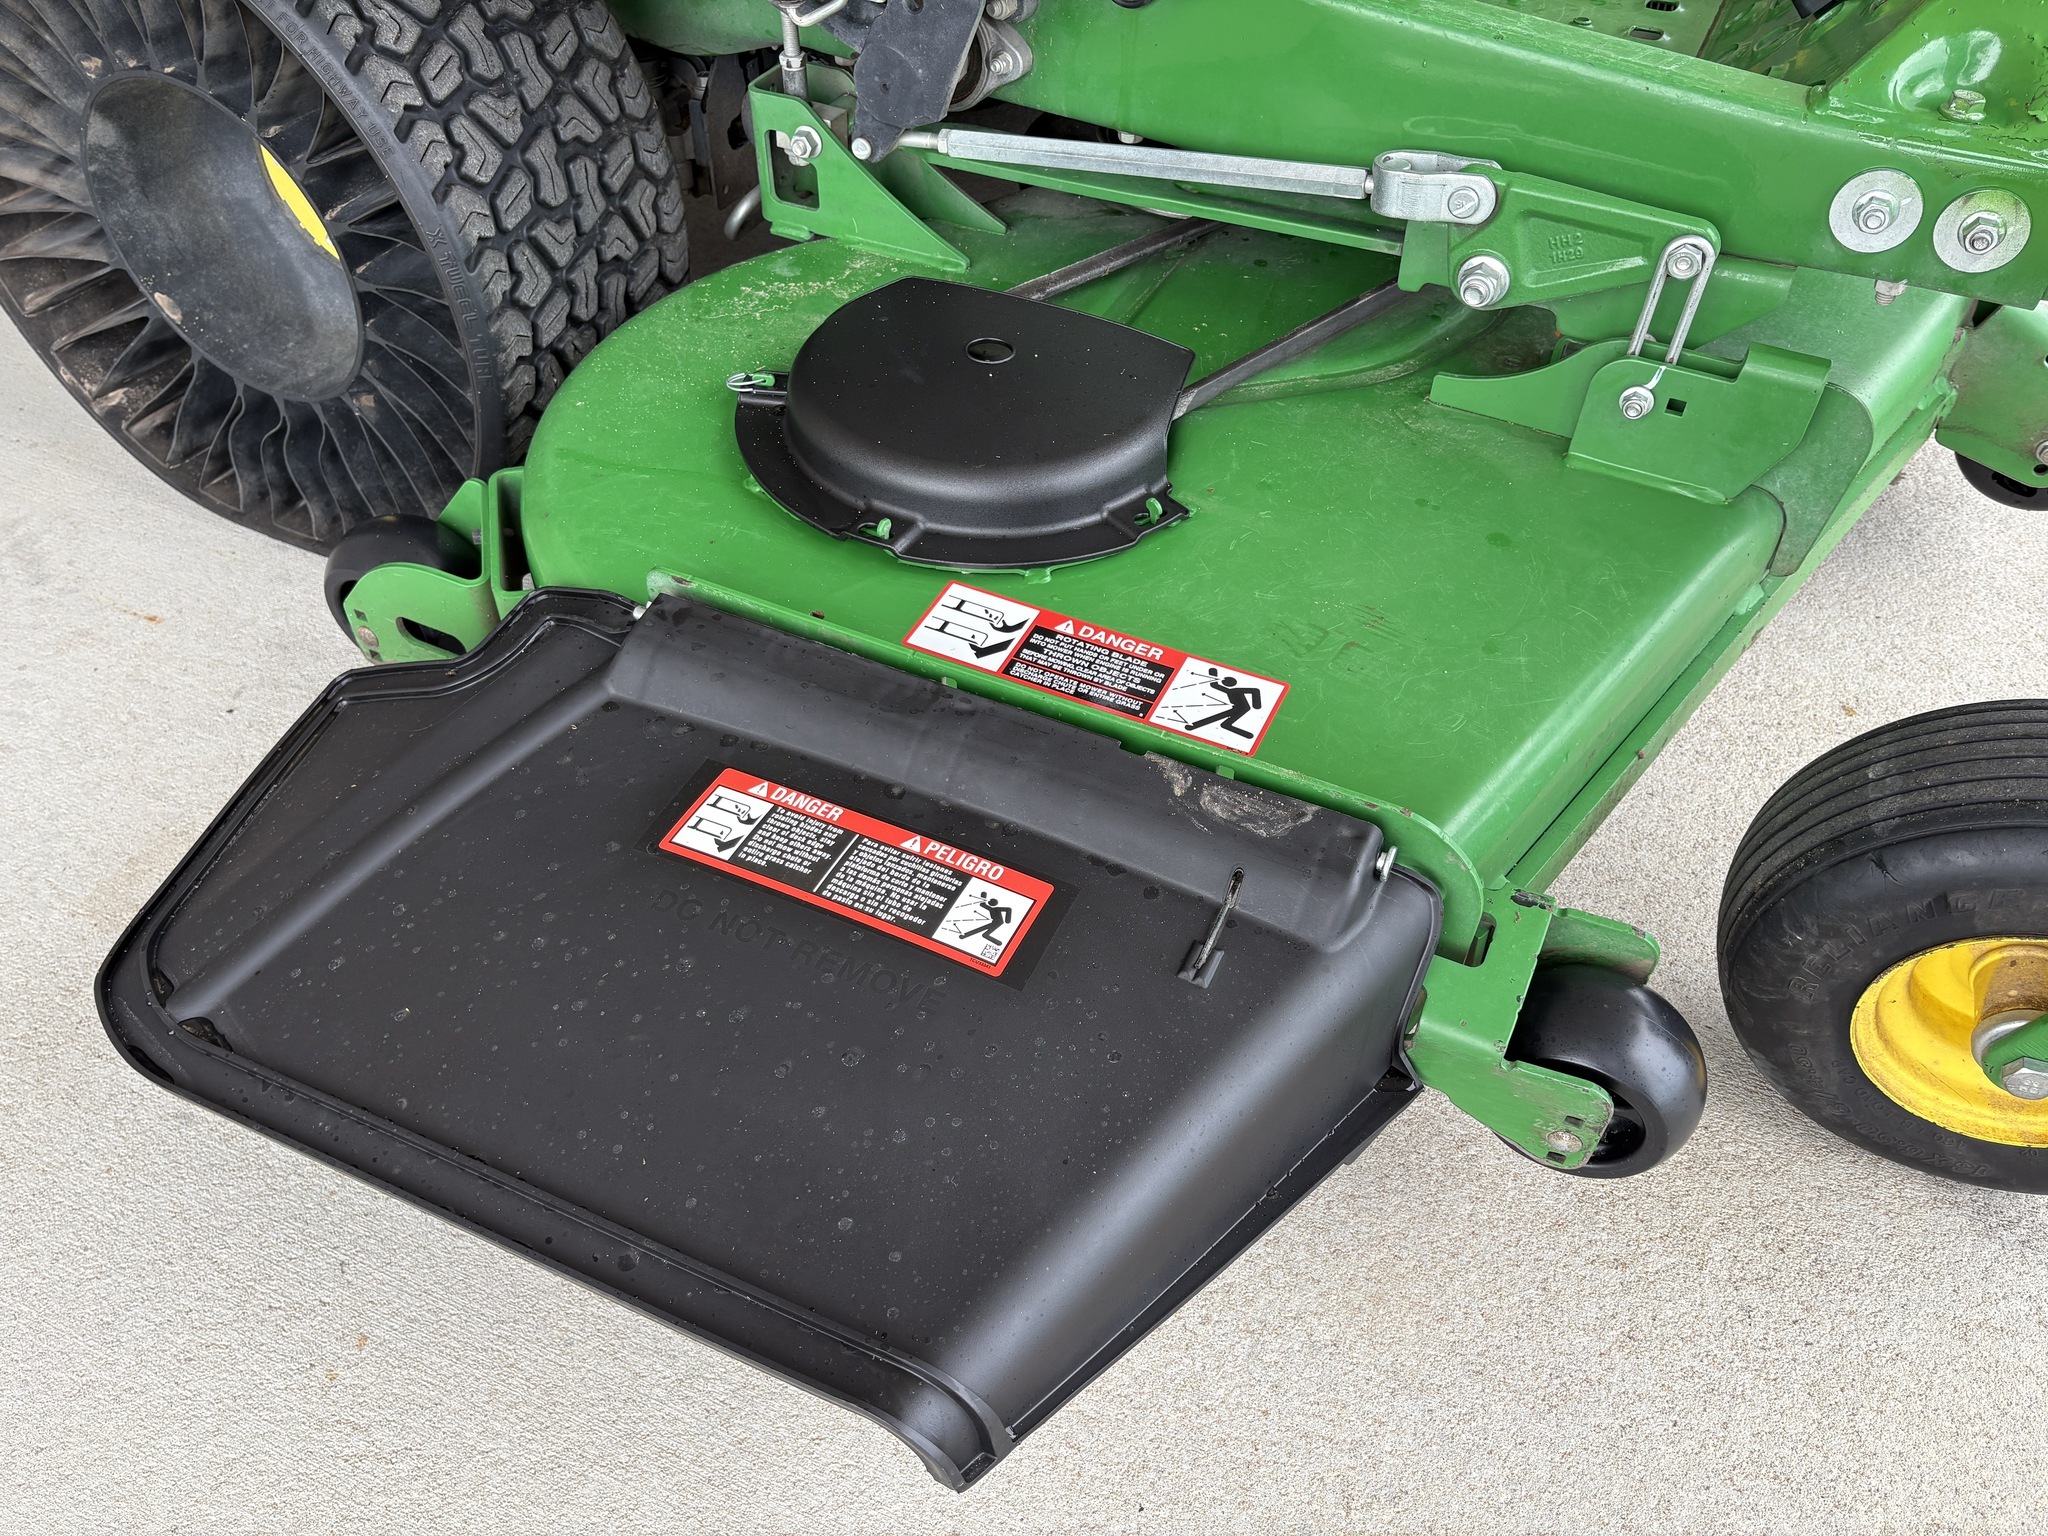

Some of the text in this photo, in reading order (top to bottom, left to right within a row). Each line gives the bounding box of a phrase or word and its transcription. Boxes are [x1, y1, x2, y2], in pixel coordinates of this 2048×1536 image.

[276, 12, 395, 157] FOR HIGHWAY USE
[439, 250, 477, 329] TWEEL
[1043, 637, 1059, 645] NOT
[1073, 646, 1098, 657] HANDS
[1109, 657, 1128, 666] FEET
[1128, 663, 1154, 674] UNDER
[1055, 634, 1149, 667] ROTATING BLADE
[1077, 625, 1165, 660] DANGER
[1018, 653, 1037, 662] THAT
[1037, 659, 1052, 667] MAY
[1062, 667, 1093, 680] THROWN
[1103, 680, 1128, 691] BLADE
[1021, 648, 1048, 660] BEFORE
[1075, 665, 1097, 676] CLEAR
[1096, 672, 1115, 681] AREA
[1124, 681, 1155, 694] OBJECTS
[1028, 638, 1046, 646] INTO
[1046, 643, 1073, 655] MOWER
[1073, 652, 1094, 662] WHEN
[1094, 659, 1121, 670] ENGINE
[1129, 669, 1162, 683] RUNNING
[1041, 648, 1141, 683] THROWN OBJECTS
[1009, 670, 1043, 684] CATCHER
[1051, 683, 1075, 694] PLACE
[1011, 666, 1052, 682] DISCHARGE
[1052, 679, 1076, 690] CHUTE
[1088, 690, 1115, 702] ENTIRE
[1114, 699, 1140, 710] GRASS
[1026, 666, 1043, 674] NOT
[1043, 671, 1078, 685] OPERATE
[1079, 682, 1108, 695] MOWER
[1108, 692, 1143, 706] WITHOUT
[769, 787, 844, 822] DANGER
[785, 810, 806, 821] avoid
[804, 817, 827, 829] injury
[826, 824, 844, 834] from
[756, 828, 771, 837] and
[770, 833, 789, 844] keep
[788, 839, 812, 852] others
[761, 823, 780, 833] clear
[788, 833, 806, 842] deck
[805, 839, 824, 850] edge
[766, 817, 791, 829] thrown
[818, 836, 835, 846] stay
[770, 811, 837, 839] rotating blades and
[742, 845, 812, 874] entire grass catcher
[746, 839, 782, 856] discharge
[781, 852, 802, 863] chute
[762, 838, 776, 846] not
[775, 842, 793, 852] mow
[792, 848, 820, 862] without
[857, 843, 963, 887] causadas por cuchillas giratorias
[861, 838, 953, 875] Para evitar sufrir lesiones
[924, 841, 1005, 880] PELIGRO
[843, 860, 881, 877] plataforma
[880, 873, 890, 881] de
[890, 877, 909, 887] corte
[914, 886, 948, 902] mantener
[848, 854, 876, 869] alejado
[875, 864, 889, 873] del
[889, 869, 910, 880] borde
[910, 877, 922, 885] de
[857, 851, 883, 864] objetos
[916, 872, 956, 891] mantenerse
[821, 889, 832, 897] de
[831, 893, 853, 906] pasto
[863, 905, 874, 913] su
[825, 883, 861, 901] descarga
[865, 898, 879, 907] sin
[887, 907, 926, 926] recogedor
[829, 877, 862, 894] máquina
[862, 889, 875, 898] sin
[883, 897, 902, 908] tubo
[901, 904, 913, 912] de
[835, 871, 846, 879] de
[889, 891, 901, 900] No
[901, 896, 918, 906] usar
[845, 868, 858, 876] las
[857, 872, 881, 884] demás
[880, 881, 913, 897] personas
[912, 893, 944, 909] alejadas
[652, 889, 946, 1016] DO NOT REMOVE
